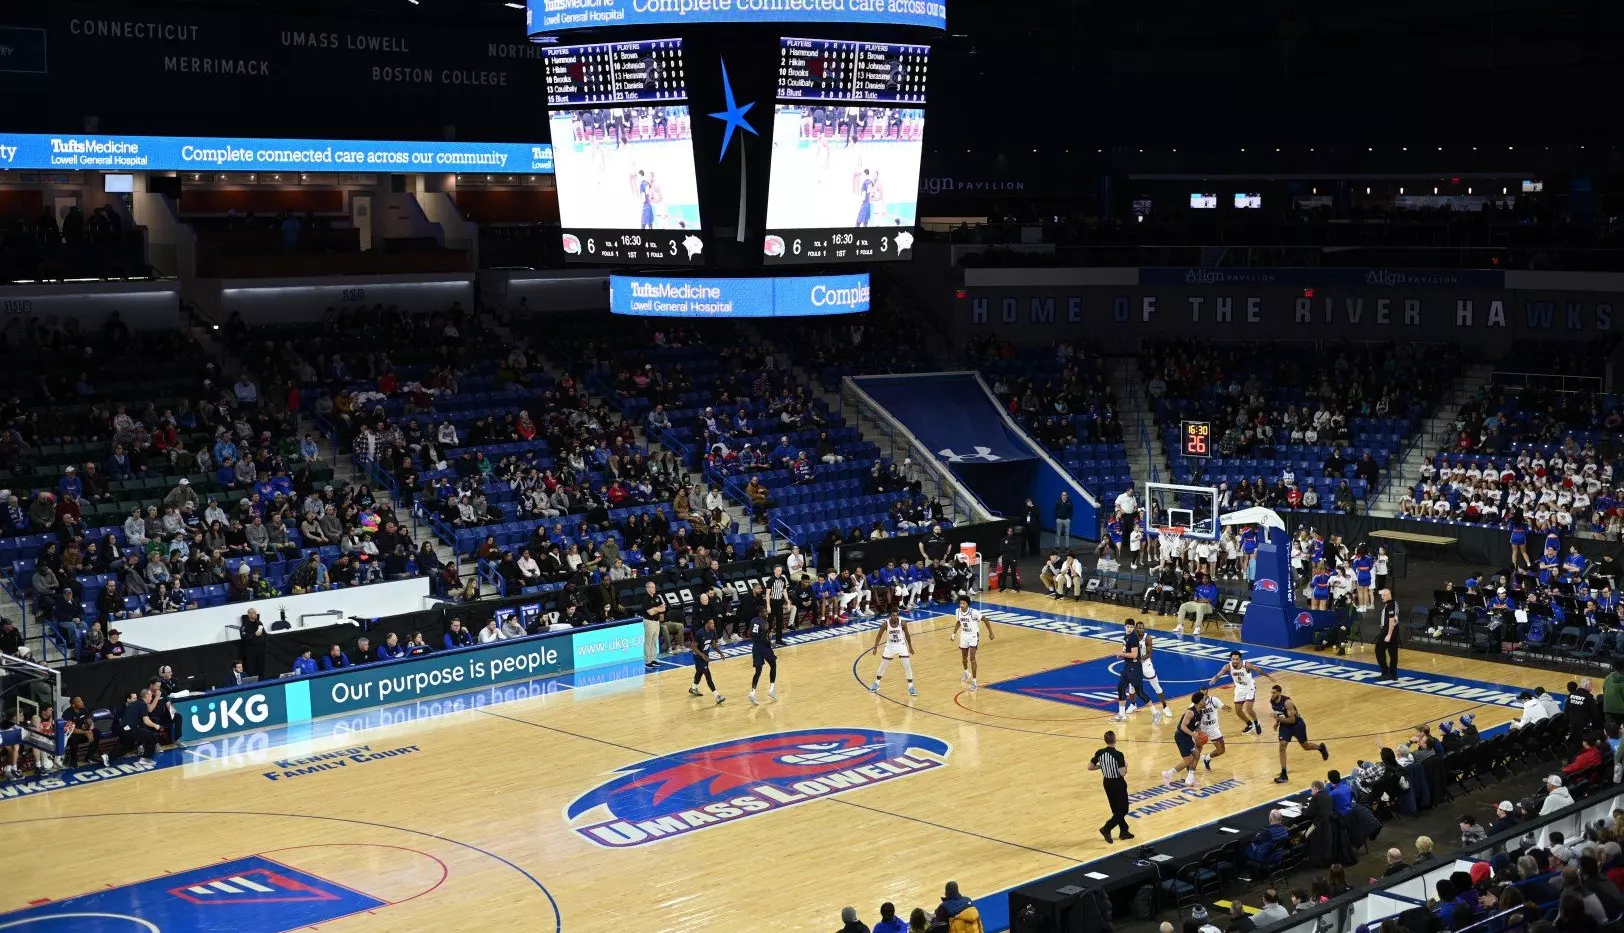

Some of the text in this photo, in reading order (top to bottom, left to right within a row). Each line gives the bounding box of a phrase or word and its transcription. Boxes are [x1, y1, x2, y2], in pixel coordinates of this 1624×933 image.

[849, 0, 885, 11] care
[888, 0, 925, 14] across
[562, 12, 588, 24] General
[590, 9, 624, 21] Hospital
[70, 18, 199, 41] CONNECTICUT
[281, 31, 409, 52] UMASS LOWELL
[488, 43, 541, 60] NORTH
[789, 49, 819, 57] Hammond
[867, 52, 885, 60] Brown
[164, 56, 269, 76] MERRIMACK
[779, 68, 809, 77] 10 Brooks
[866, 63, 890, 71] Johnson
[372, 66, 507, 86] BOSTON COLLEGE
[553, 76, 571, 84] Brooks
[778, 78, 786, 86] 13
[787, 89, 802, 97] Blunt
[865, 82, 885, 90] Daniels
[51, 155, 148, 167] Lowell General Hospital
[181, 145, 508, 168] Complete connected care across our community
[958, 181, 1024, 190] PAVILION
[587, 238, 596, 254] 6
[620, 236, 641, 246] 16:30
[669, 239, 677, 255] 3
[792, 238, 801, 254] 6
[832, 234, 853, 245] 16:30
[880, 236, 888, 252] 3
[1185, 268, 1224, 284] Align
[1366, 269, 1406, 285] Align
[630, 300, 652, 310] Lowell
[653, 301, 688, 312] General
[690, 301, 732, 313] Hospital
[972, 296, 1083, 324] HOME
[1113, 296, 1157, 324] OF
[1188, 296, 1262, 324] THE
[1295, 297, 1421, 325] RIVER
[1188, 424, 1208, 436] 16:30
[1188, 435, 1206, 452] 26
[752, 623, 760, 634] 21
[576, 634, 644, 657] www.ukg.co
[331, 680, 373, 703] Our
[378, 665, 464, 701] purpose
[469, 658, 485, 679] is
[490, 646, 558, 680] people
[1374, 676, 1535, 708] HAWK
[262, 745, 420, 781] FAMILY COURT
